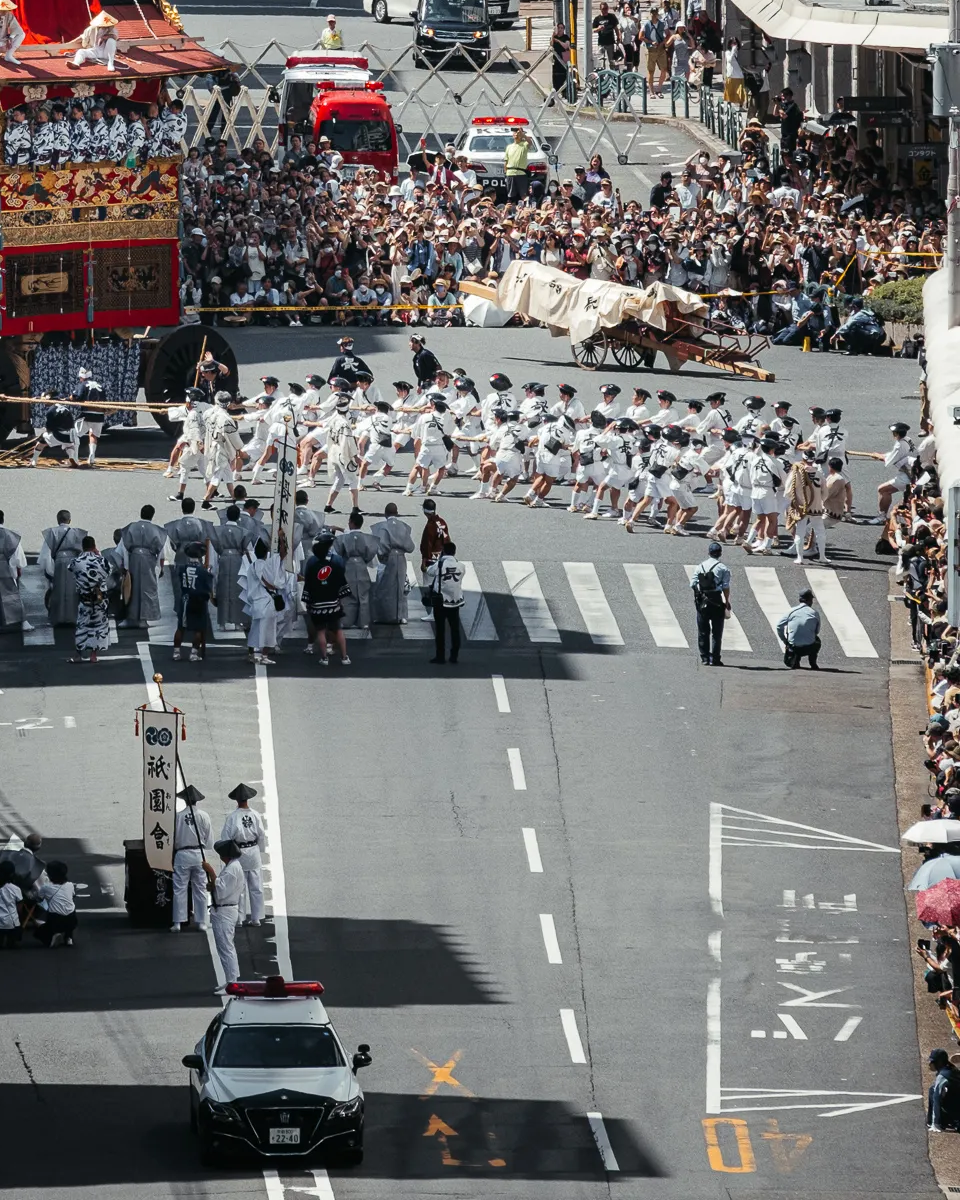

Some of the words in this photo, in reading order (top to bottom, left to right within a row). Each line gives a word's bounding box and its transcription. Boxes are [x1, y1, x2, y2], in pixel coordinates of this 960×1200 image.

[908, 149, 937, 157] コンタクト
[482, 179, 506, 187] POL
[442, 567, 461, 582] 長
[147, 754, 169, 851] 祇園會
